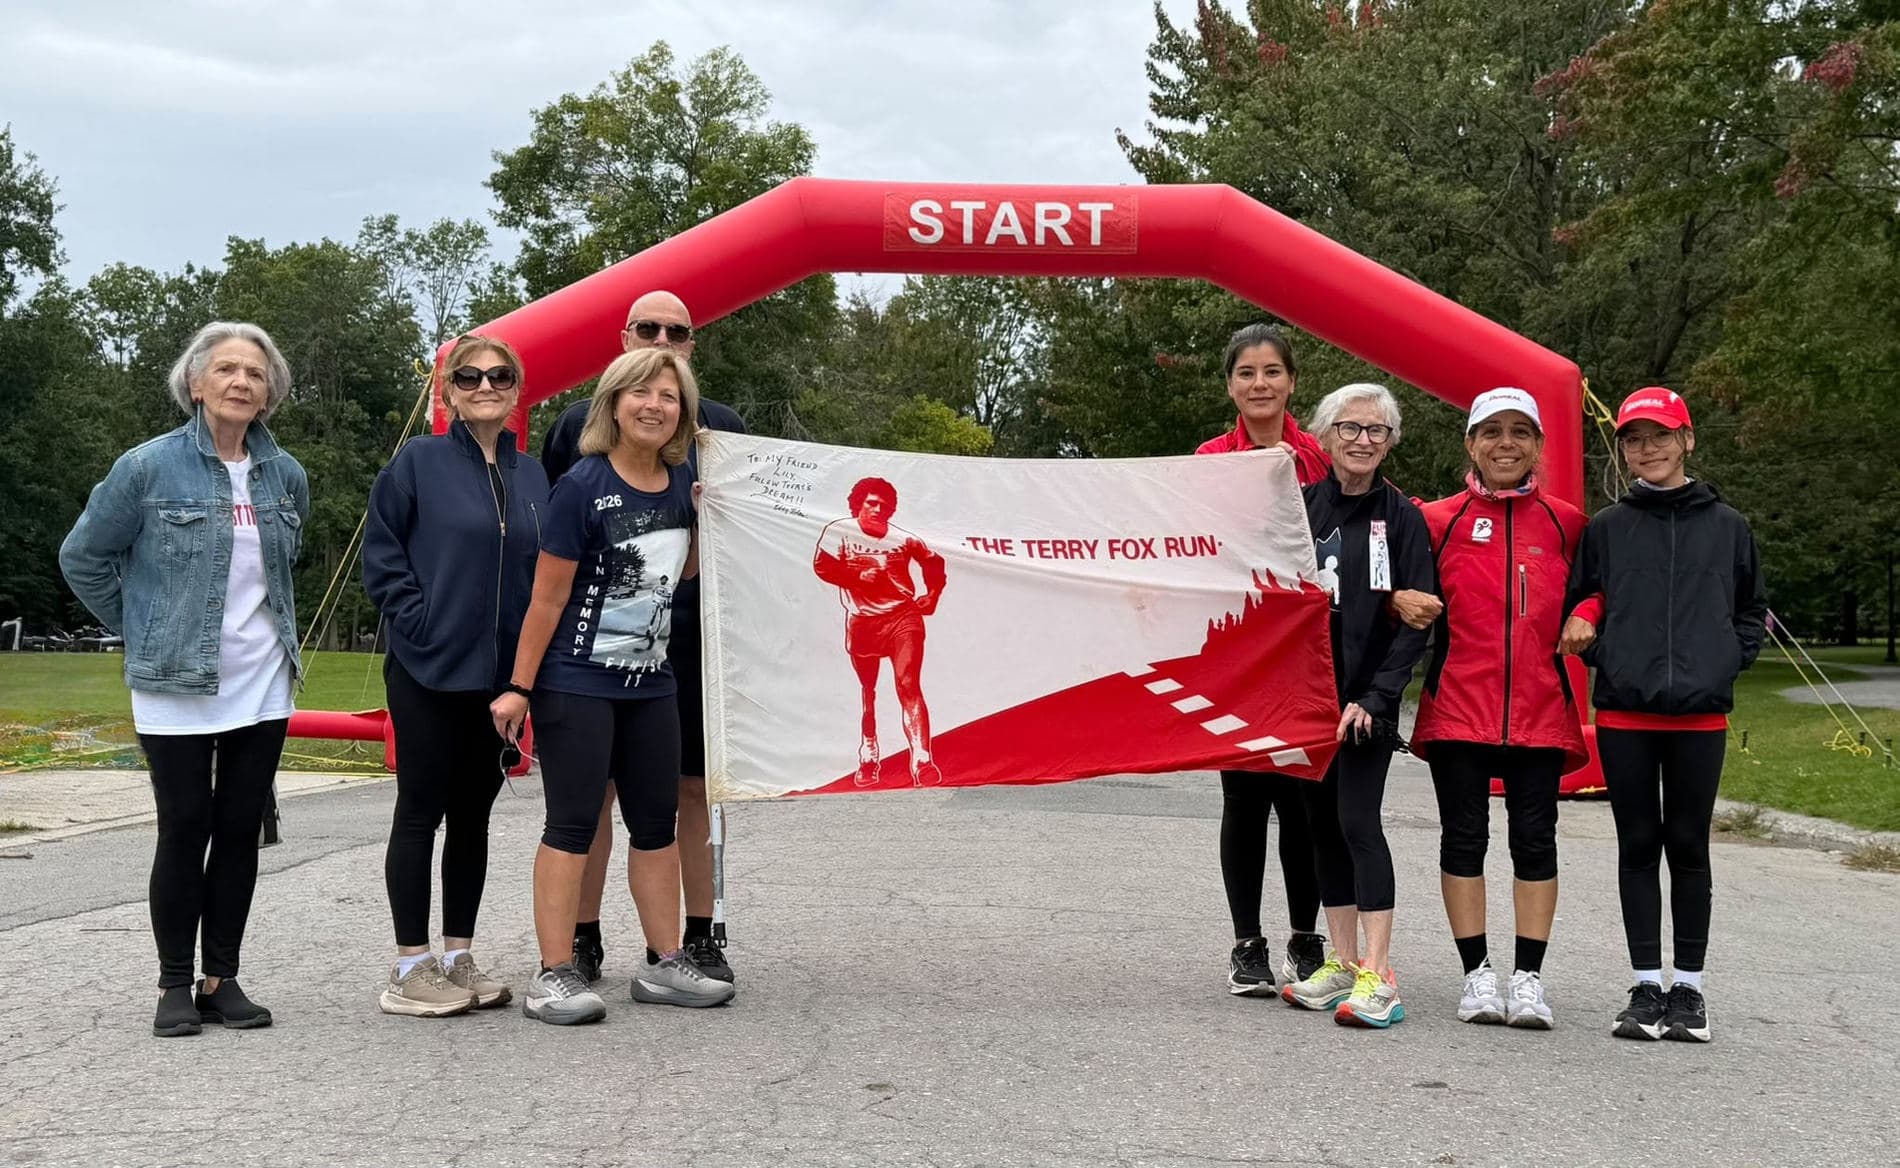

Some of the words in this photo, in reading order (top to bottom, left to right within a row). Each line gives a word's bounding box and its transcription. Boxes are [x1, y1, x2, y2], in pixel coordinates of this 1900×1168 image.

[908, 200, 1114, 246] START
[765, 455, 783, 466] MY
[786, 457, 818, 470] FRIEND
[966, 536, 1016, 556] THE
[1021, 539, 1099, 560] TERRY
[1108, 537, 1158, 560] FOX
[1164, 534, 1218, 558] RUN
[572, 585, 599, 656] MEMORY
